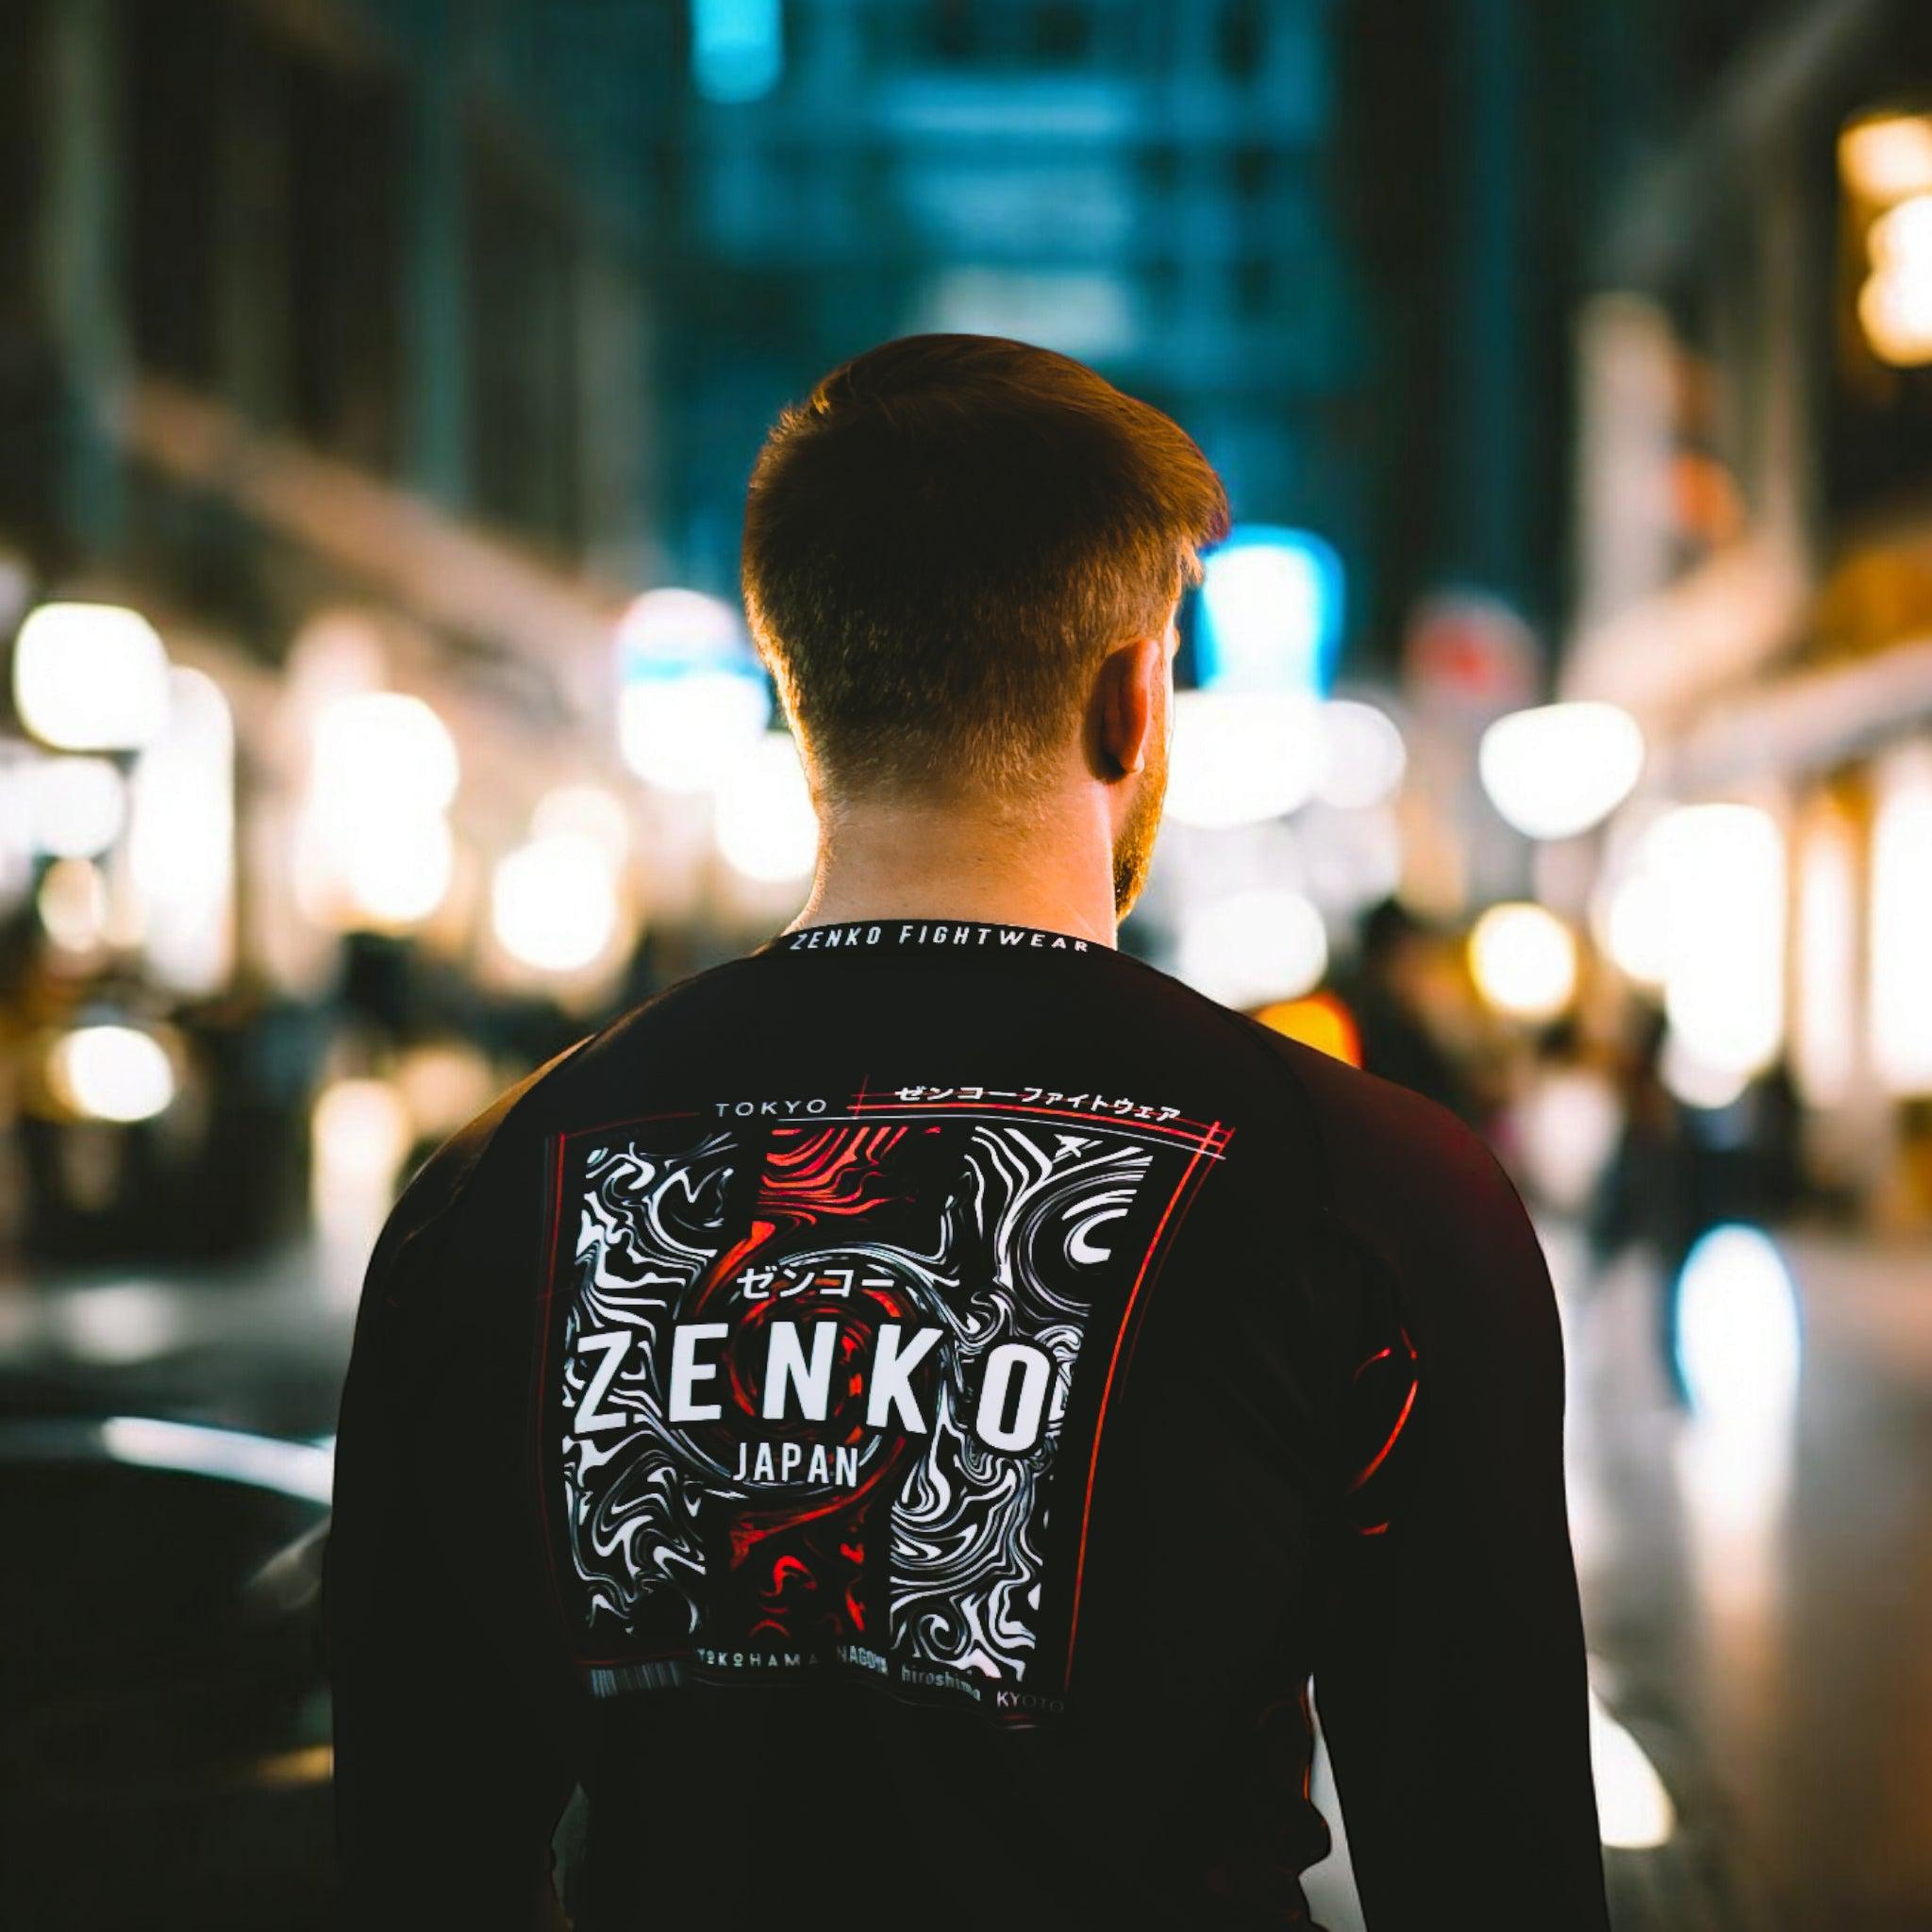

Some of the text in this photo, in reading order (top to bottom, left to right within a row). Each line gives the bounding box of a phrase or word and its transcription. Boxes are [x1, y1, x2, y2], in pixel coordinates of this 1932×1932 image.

[791, 924, 1088, 952] ZENKO FIGHTWEAR
[716, 1099, 827, 1117] TOKYO
[894, 1086, 1181, 1122] ゼンコーファイトウェア
[737, 1268, 894, 1299] ゼンコー
[574, 1321, 1051, 1452] ZENKO
[732, 1441, 858, 1488] JAPAN
[996, 1690, 1065, 1715] KYOTO
